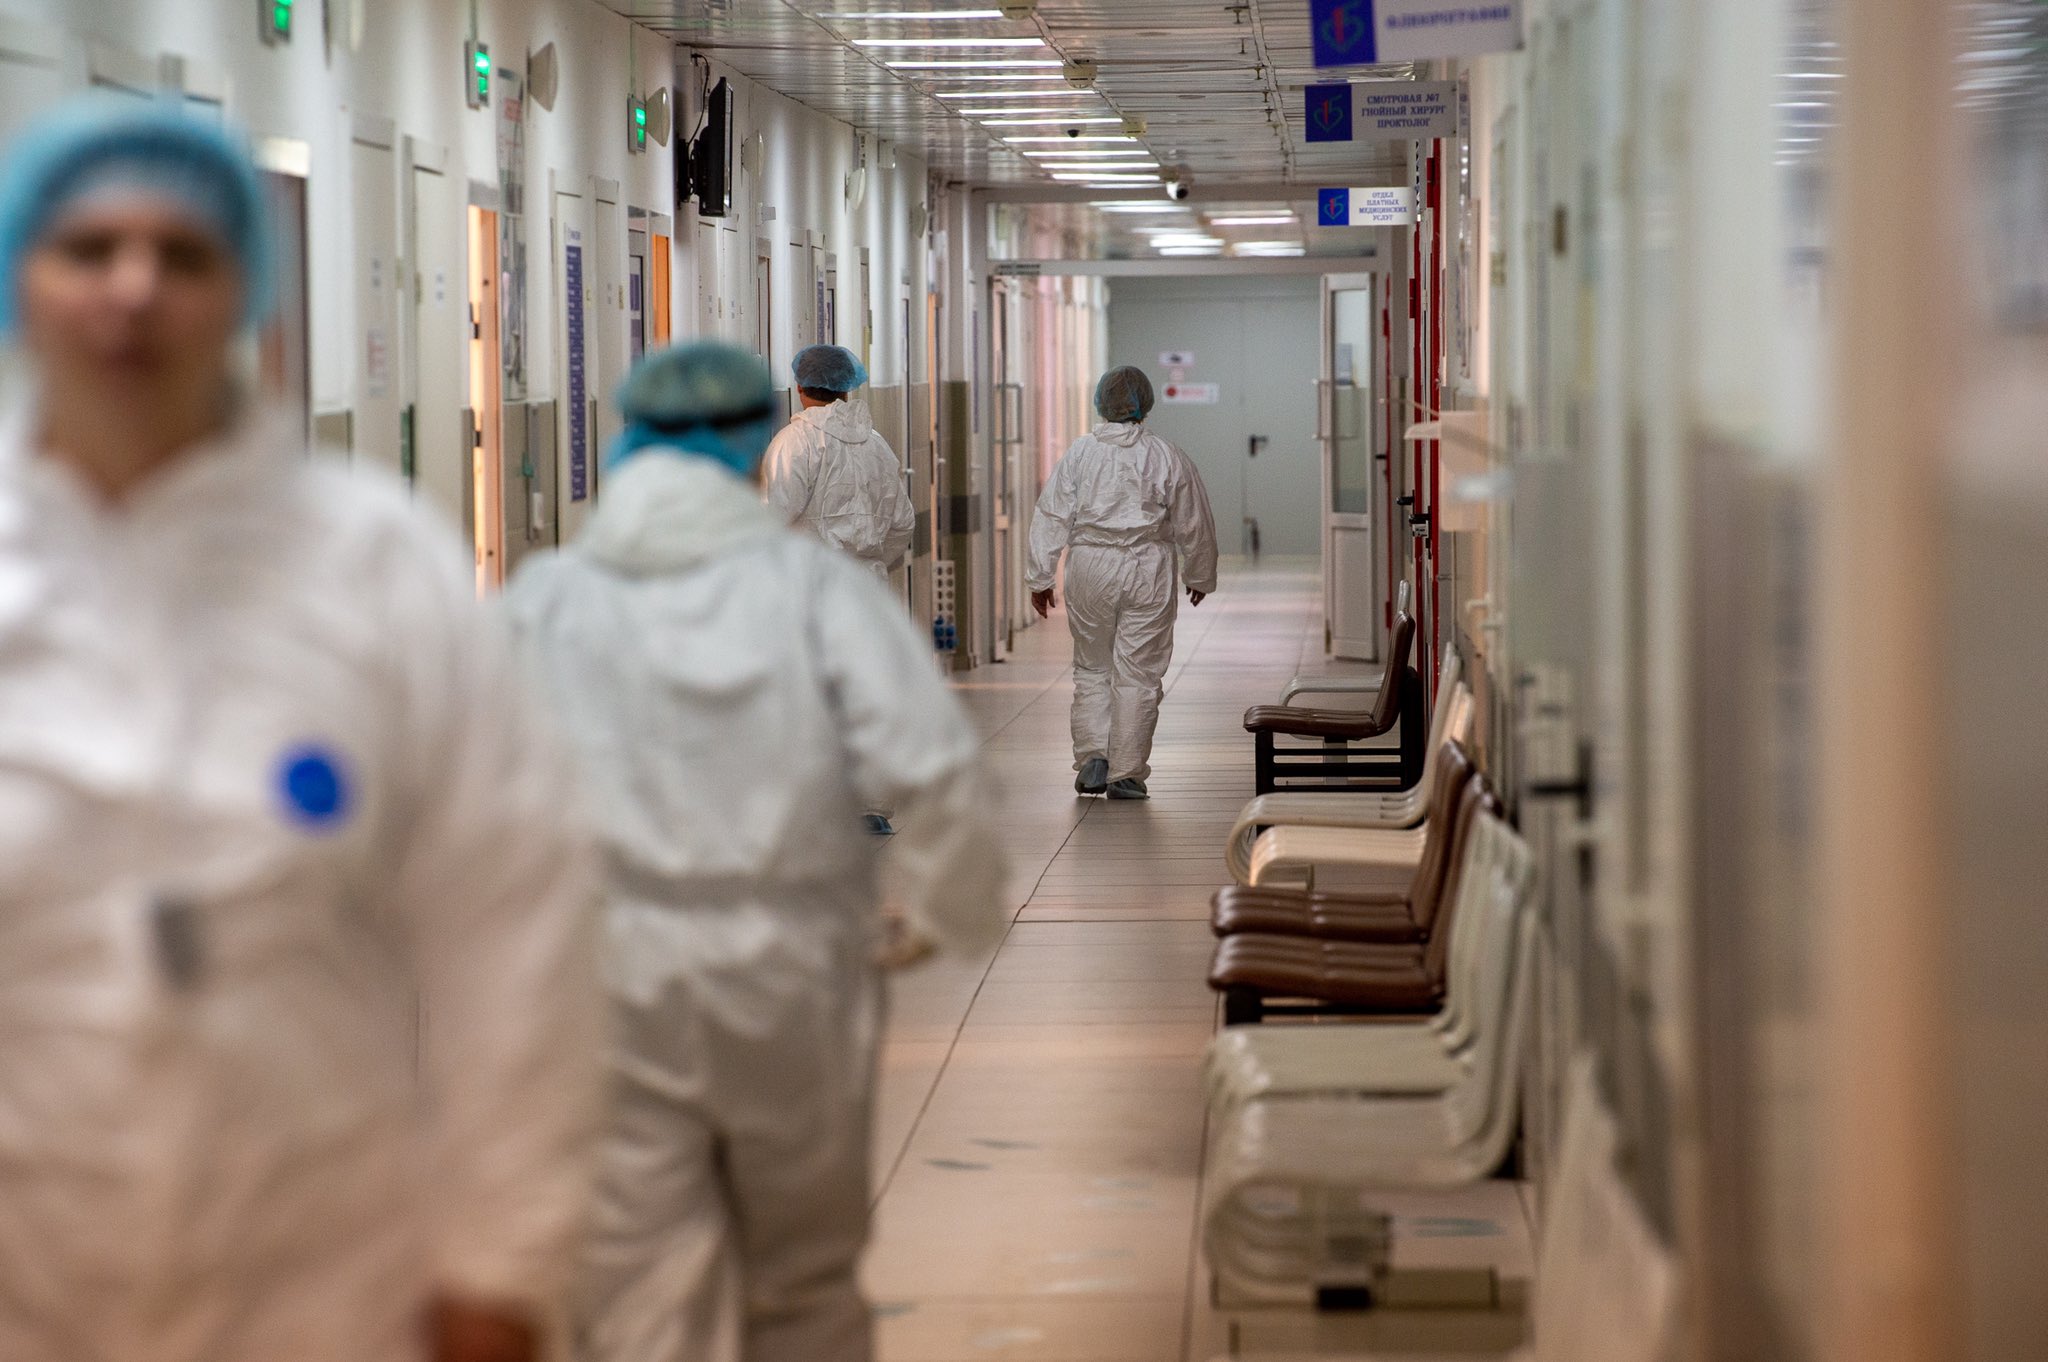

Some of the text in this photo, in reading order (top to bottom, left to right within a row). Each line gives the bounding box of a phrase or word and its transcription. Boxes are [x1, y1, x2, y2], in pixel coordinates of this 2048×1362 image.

[1367, 93, 1440, 104] СМОТРОВАЯ №7
[1361, 105, 1446, 117] ГНОЙНЫЙ ХИРУРГ
[1377, 118, 1431, 128] ПРОКТОЛОГ
